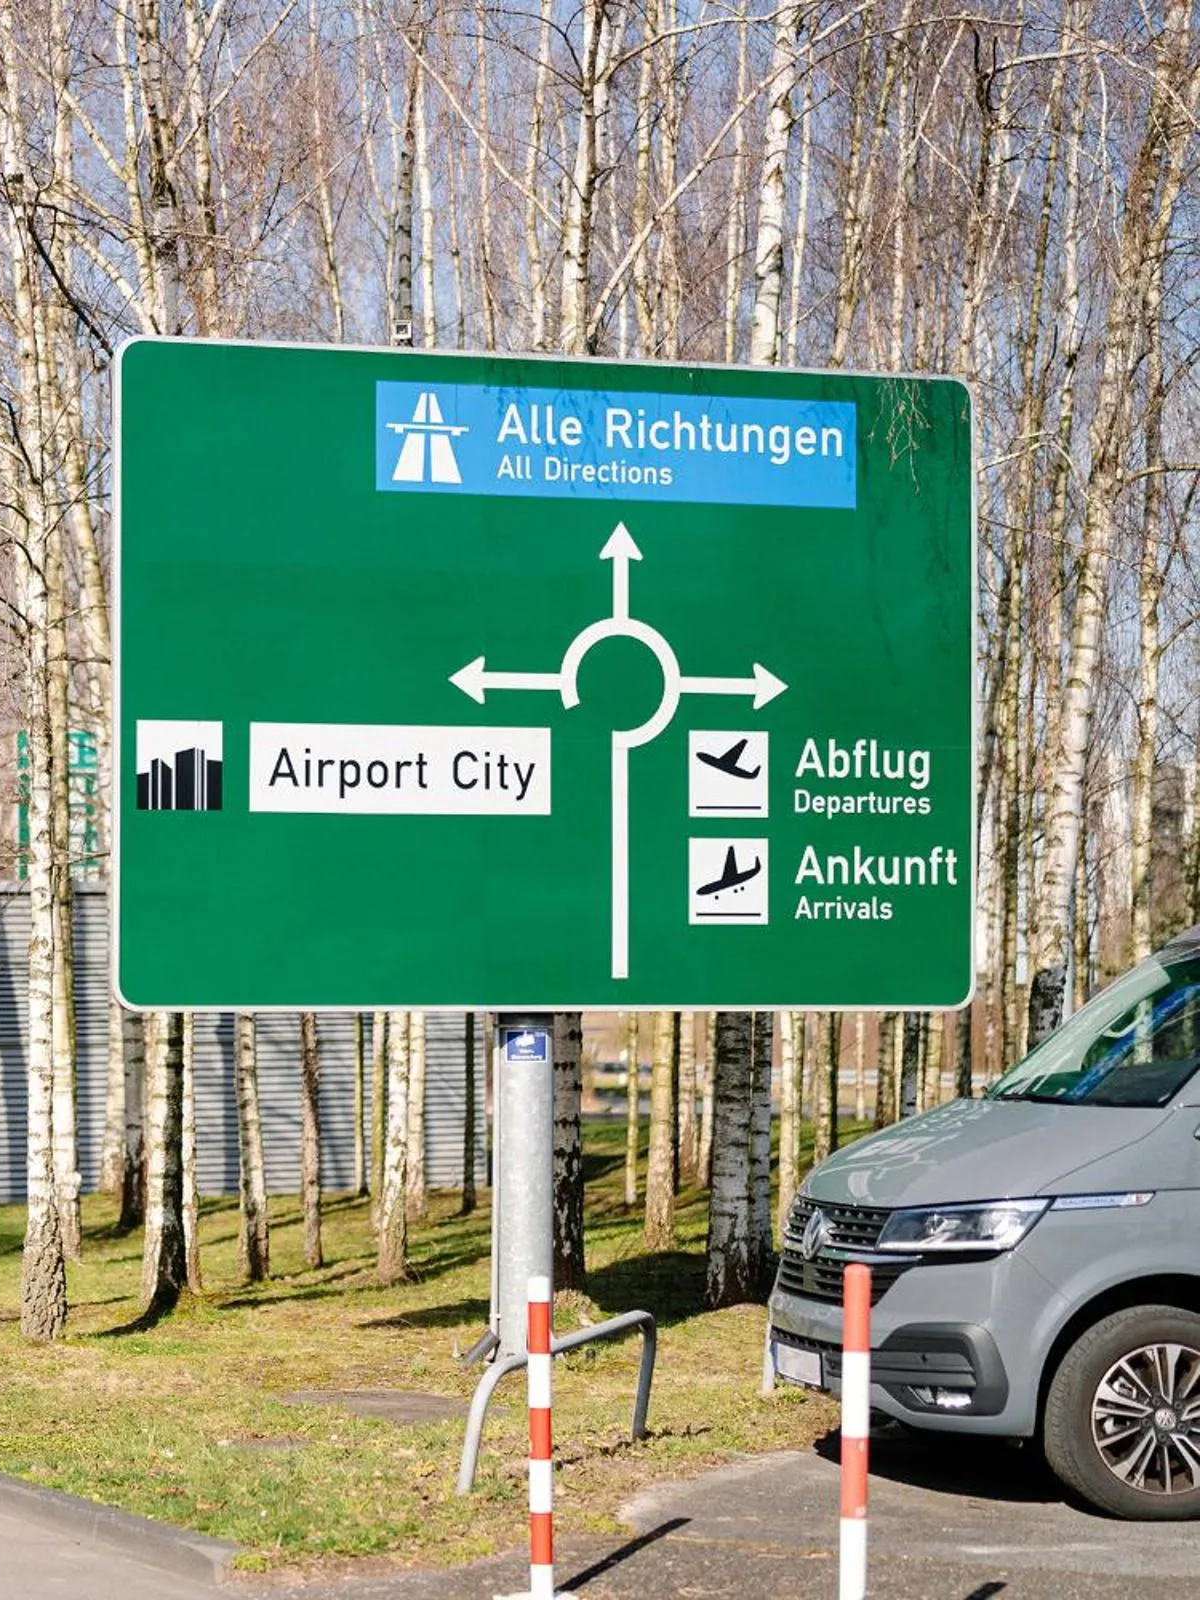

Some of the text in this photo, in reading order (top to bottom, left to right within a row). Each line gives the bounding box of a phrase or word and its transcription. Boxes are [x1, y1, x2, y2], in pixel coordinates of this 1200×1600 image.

[497, 404, 843, 465] Alle Richtungen
[497, 455, 672, 484] All Directions
[269, 748, 535, 800] Airport City
[796, 739, 929, 789] Abflug
[795, 790, 930, 818] Departures
[796, 846, 956, 884] Ankunft
[795, 896, 892, 919] Arrivals
